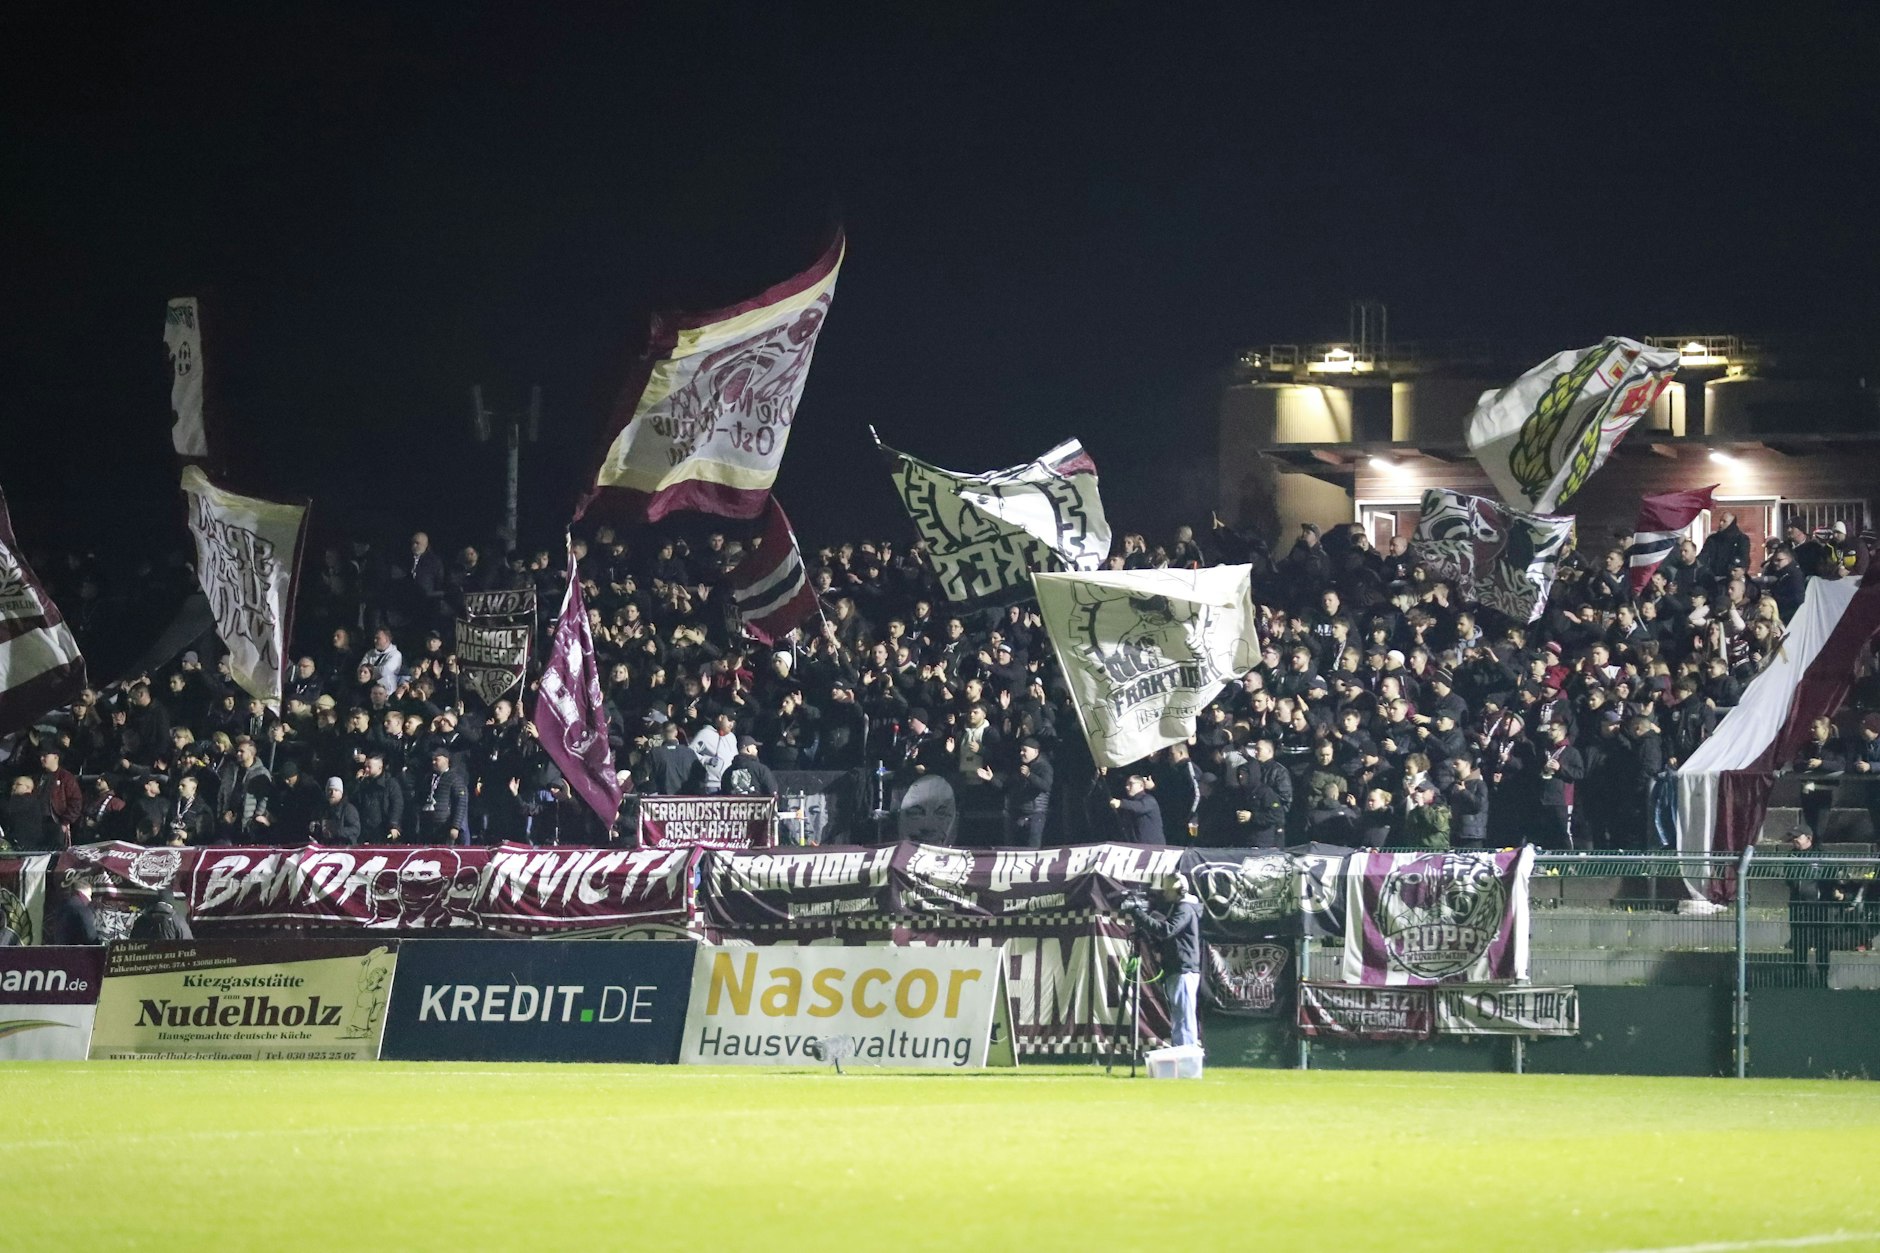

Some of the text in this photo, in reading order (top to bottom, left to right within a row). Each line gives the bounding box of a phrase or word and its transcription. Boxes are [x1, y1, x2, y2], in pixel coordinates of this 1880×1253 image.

[457, 622, 526, 649] NIEMALS
[458, 644, 525, 665] AUFGEBEN
[645, 801, 770, 822] VERBANDSSTRAFEN
[665, 820, 748, 840] ABSCHAFFEN
[196, 852, 389, 911] BANDA
[473, 849, 688, 908] INVICTA
[113, 943, 148, 952] Ab hier
[123, 952, 163, 962] Minuten
[177, 949, 197, 959] Fuß
[110, 962, 158, 973] Falkenberger
[214, 957, 237, 965] Berlin
[0, 970, 88, 991] ann.de
[183, 974, 305, 992] Kiezgaststätte
[706, 952, 982, 1019] Nascor
[134, 996, 343, 1027] Nudelholz
[419, 984, 657, 1023] KREDIT.DE
[158, 1031, 312, 1042] Hausgemachte deutsche Küche
[699, 1027, 972, 1066] Hausvealtung
[110, 1051, 357, 1060] www.nudelholz-berlin.com Tel. 030 925 25 07
